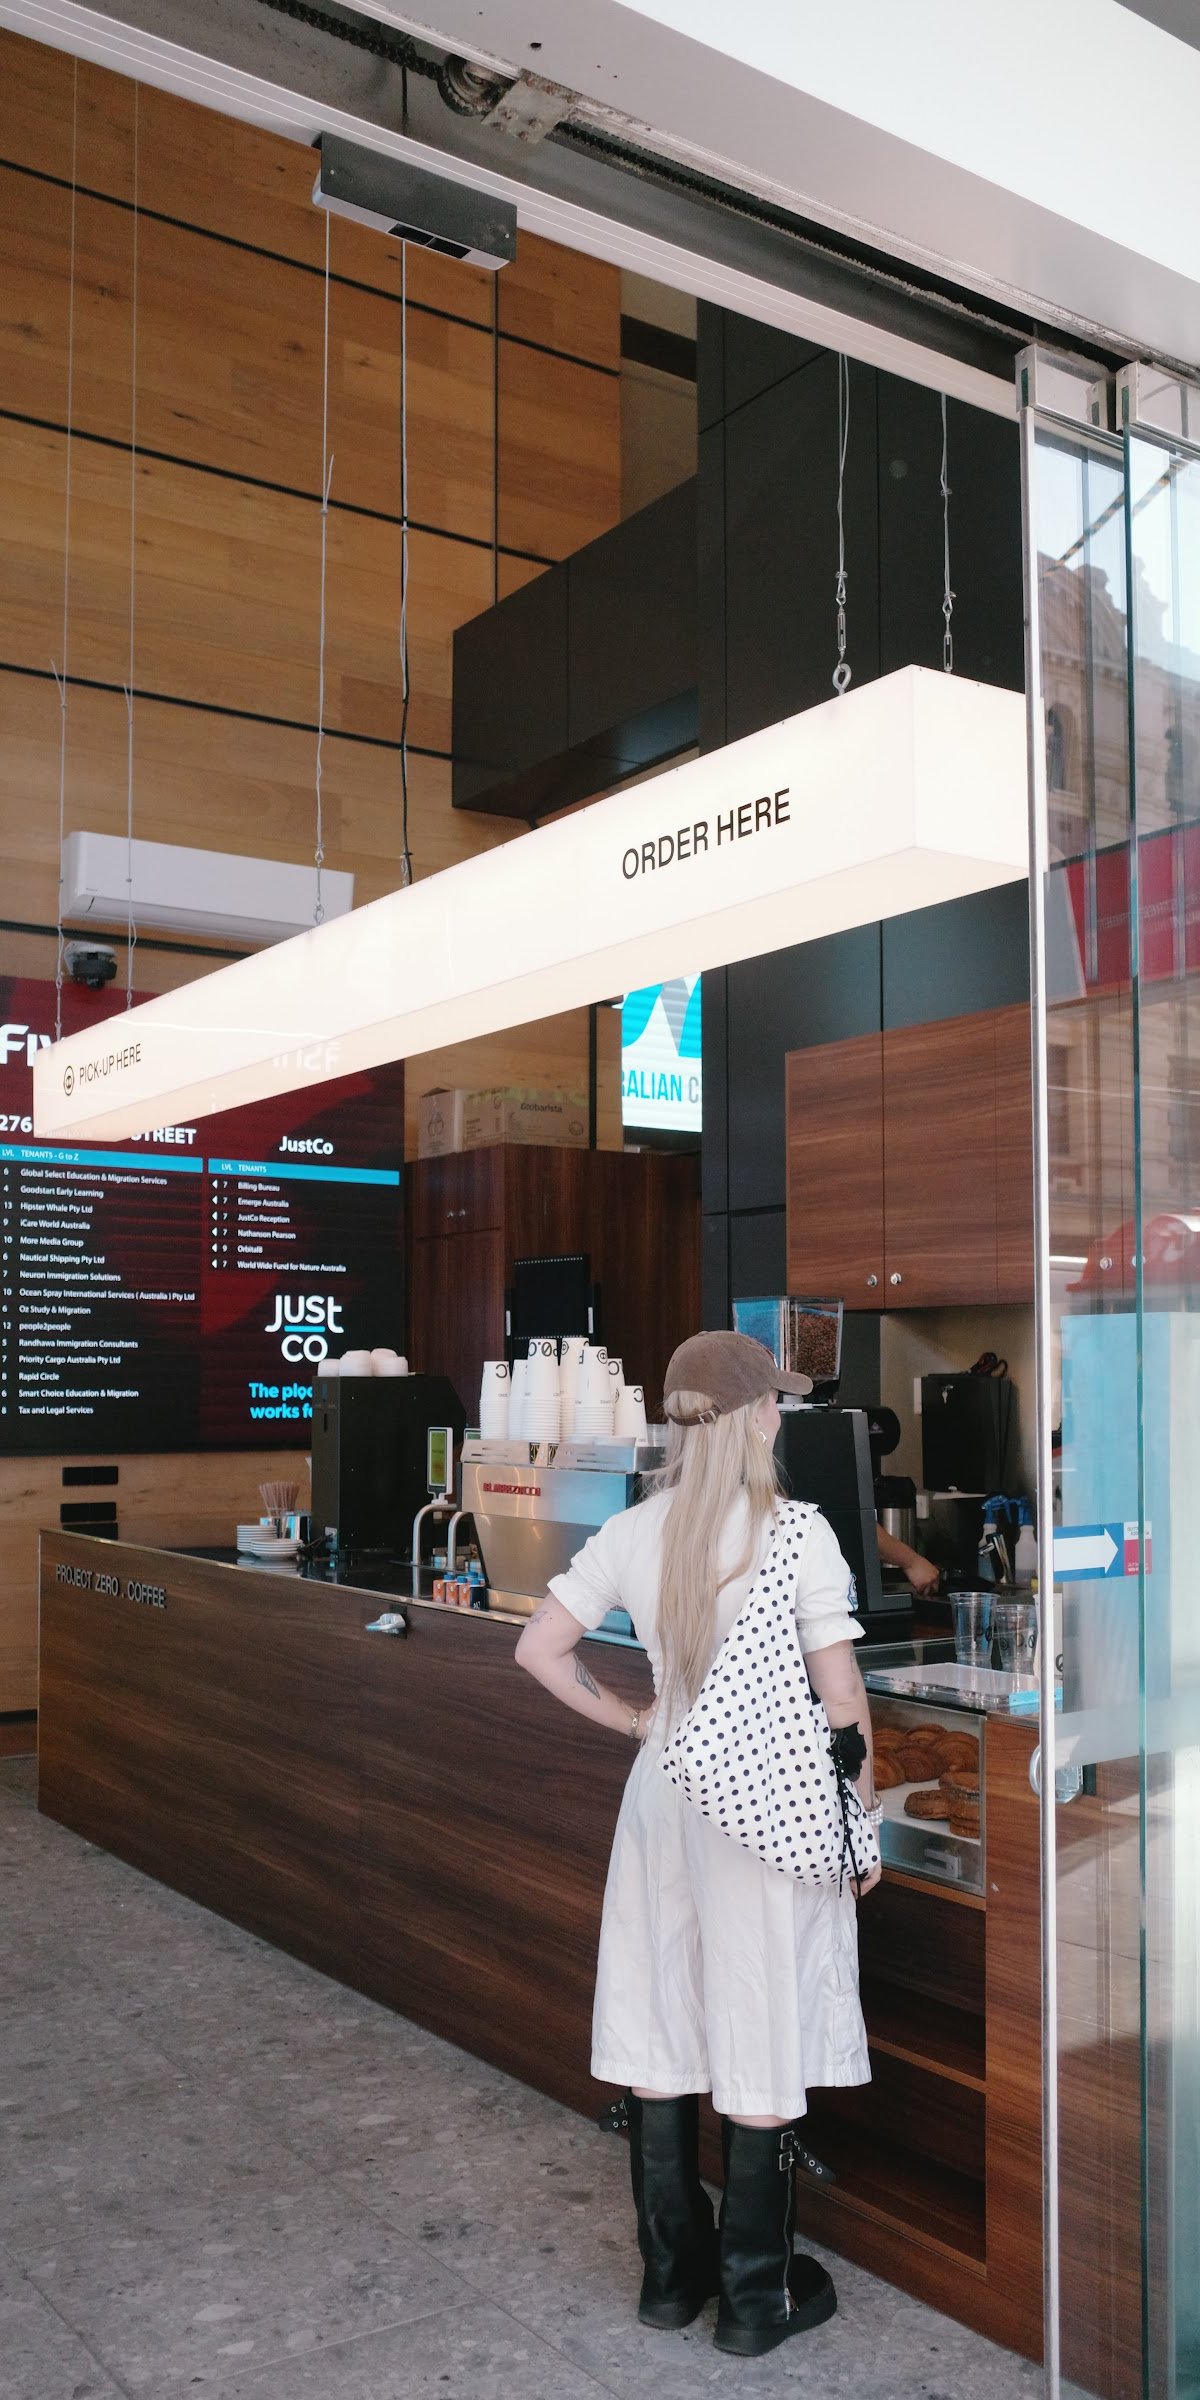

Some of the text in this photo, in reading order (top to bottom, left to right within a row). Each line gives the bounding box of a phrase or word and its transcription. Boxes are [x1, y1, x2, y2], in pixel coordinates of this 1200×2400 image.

[622, 787, 791, 880] ORDER HERE
[79, 1043, 142, 1085] PICK-UP HERE
[622, 1070, 682, 1102] ALIAN
[0, 1115, 32, 1133] 276
[279, 1136, 334, 1155] JustCo
[2, 1148, 14, 1156] LVL
[21, 1149, 53, 1159] TENANTS
[58, 1152, 64, 1160] G
[65, 1152, 73, 1160] to
[73, 1153, 79, 1161] Z
[222, 1163, 232, 1171] LVL
[238, 1164, 266, 1173] TENANTS
[3, 1167, 167, 1185] 6 Global Select Education & Migration Services
[3, 1184, 104, 1199] 4 Goodstart Early Learning
[238, 1181, 280, 1192] Billing Bureau
[4, 1201, 13, 1210] 13
[20, 1202, 45, 1211] Hipster
[46, 1204, 68, 1212] Whale
[69, 1205, 80, 1214] Pty
[238, 1197, 289, 1207] Emerge Australia
[223, 1212, 228, 1220] 7
[238, 1213, 290, 1224] JustCo Reception
[3, 1218, 9, 1227] 9
[39, 1220, 60, 1229] World
[61, 1221, 90, 1230] Australia
[223, 1228, 228, 1236] 7
[238, 1229, 296, 1239] Nathanson Pearson
[3, 1235, 84, 1248] 10 More Media Group
[2, 1252, 105, 1265] 6 Nautical Shipping Pty Ltd
[223, 1260, 228, 1268] 7
[237, 1261, 256, 1269] World
[257, 1261, 272, 1269] Wide
[273, 1262, 289, 1270] Fund
[289, 1263, 299, 1271] for
[321, 1264, 346, 1272] Australia
[2, 1270, 121, 1281] 7 Neuron Immigration Solutions
[3, 1287, 12, 1296] 10
[19, 1288, 42, 1296] Ocean
[43, 1289, 62, 1298] Spray
[63, 1290, 107, 1298] International
[108, 1290, 134, 1299] Services
[140, 1292, 168, 1300] Australia
[172, 1293, 183, 1302] Pty
[2, 1304, 91, 1316] 6 Oz Study & Migration
[3, 1322, 71, 1332] 12 people2people
[1, 1339, 138, 1349] 5 Randhawa Immigration Consultants
[1, 1355, 121, 1365] 7 Priority Cargo Australia Pty Ltd
[19, 1373, 39, 1382] Rapid
[1, 1390, 7, 1398] 6
[41, 1389, 64, 1397] Choice
[66, 1389, 99, 1397] Education
[100, 1389, 106, 1398] &
[107, 1389, 139, 1398] Migration
[249, 1382, 279, 1398] The
[31, 1406, 45, 1414] and
[46, 1406, 65, 1415] Legal
[66, 1406, 94, 1414] Services
[250, 1403, 299, 1419] works
[56, 1564, 93, 1589] PROJECT
[95, 1573, 119, 1597] ZERO
[128, 1581, 165, 1609] COFFEE
